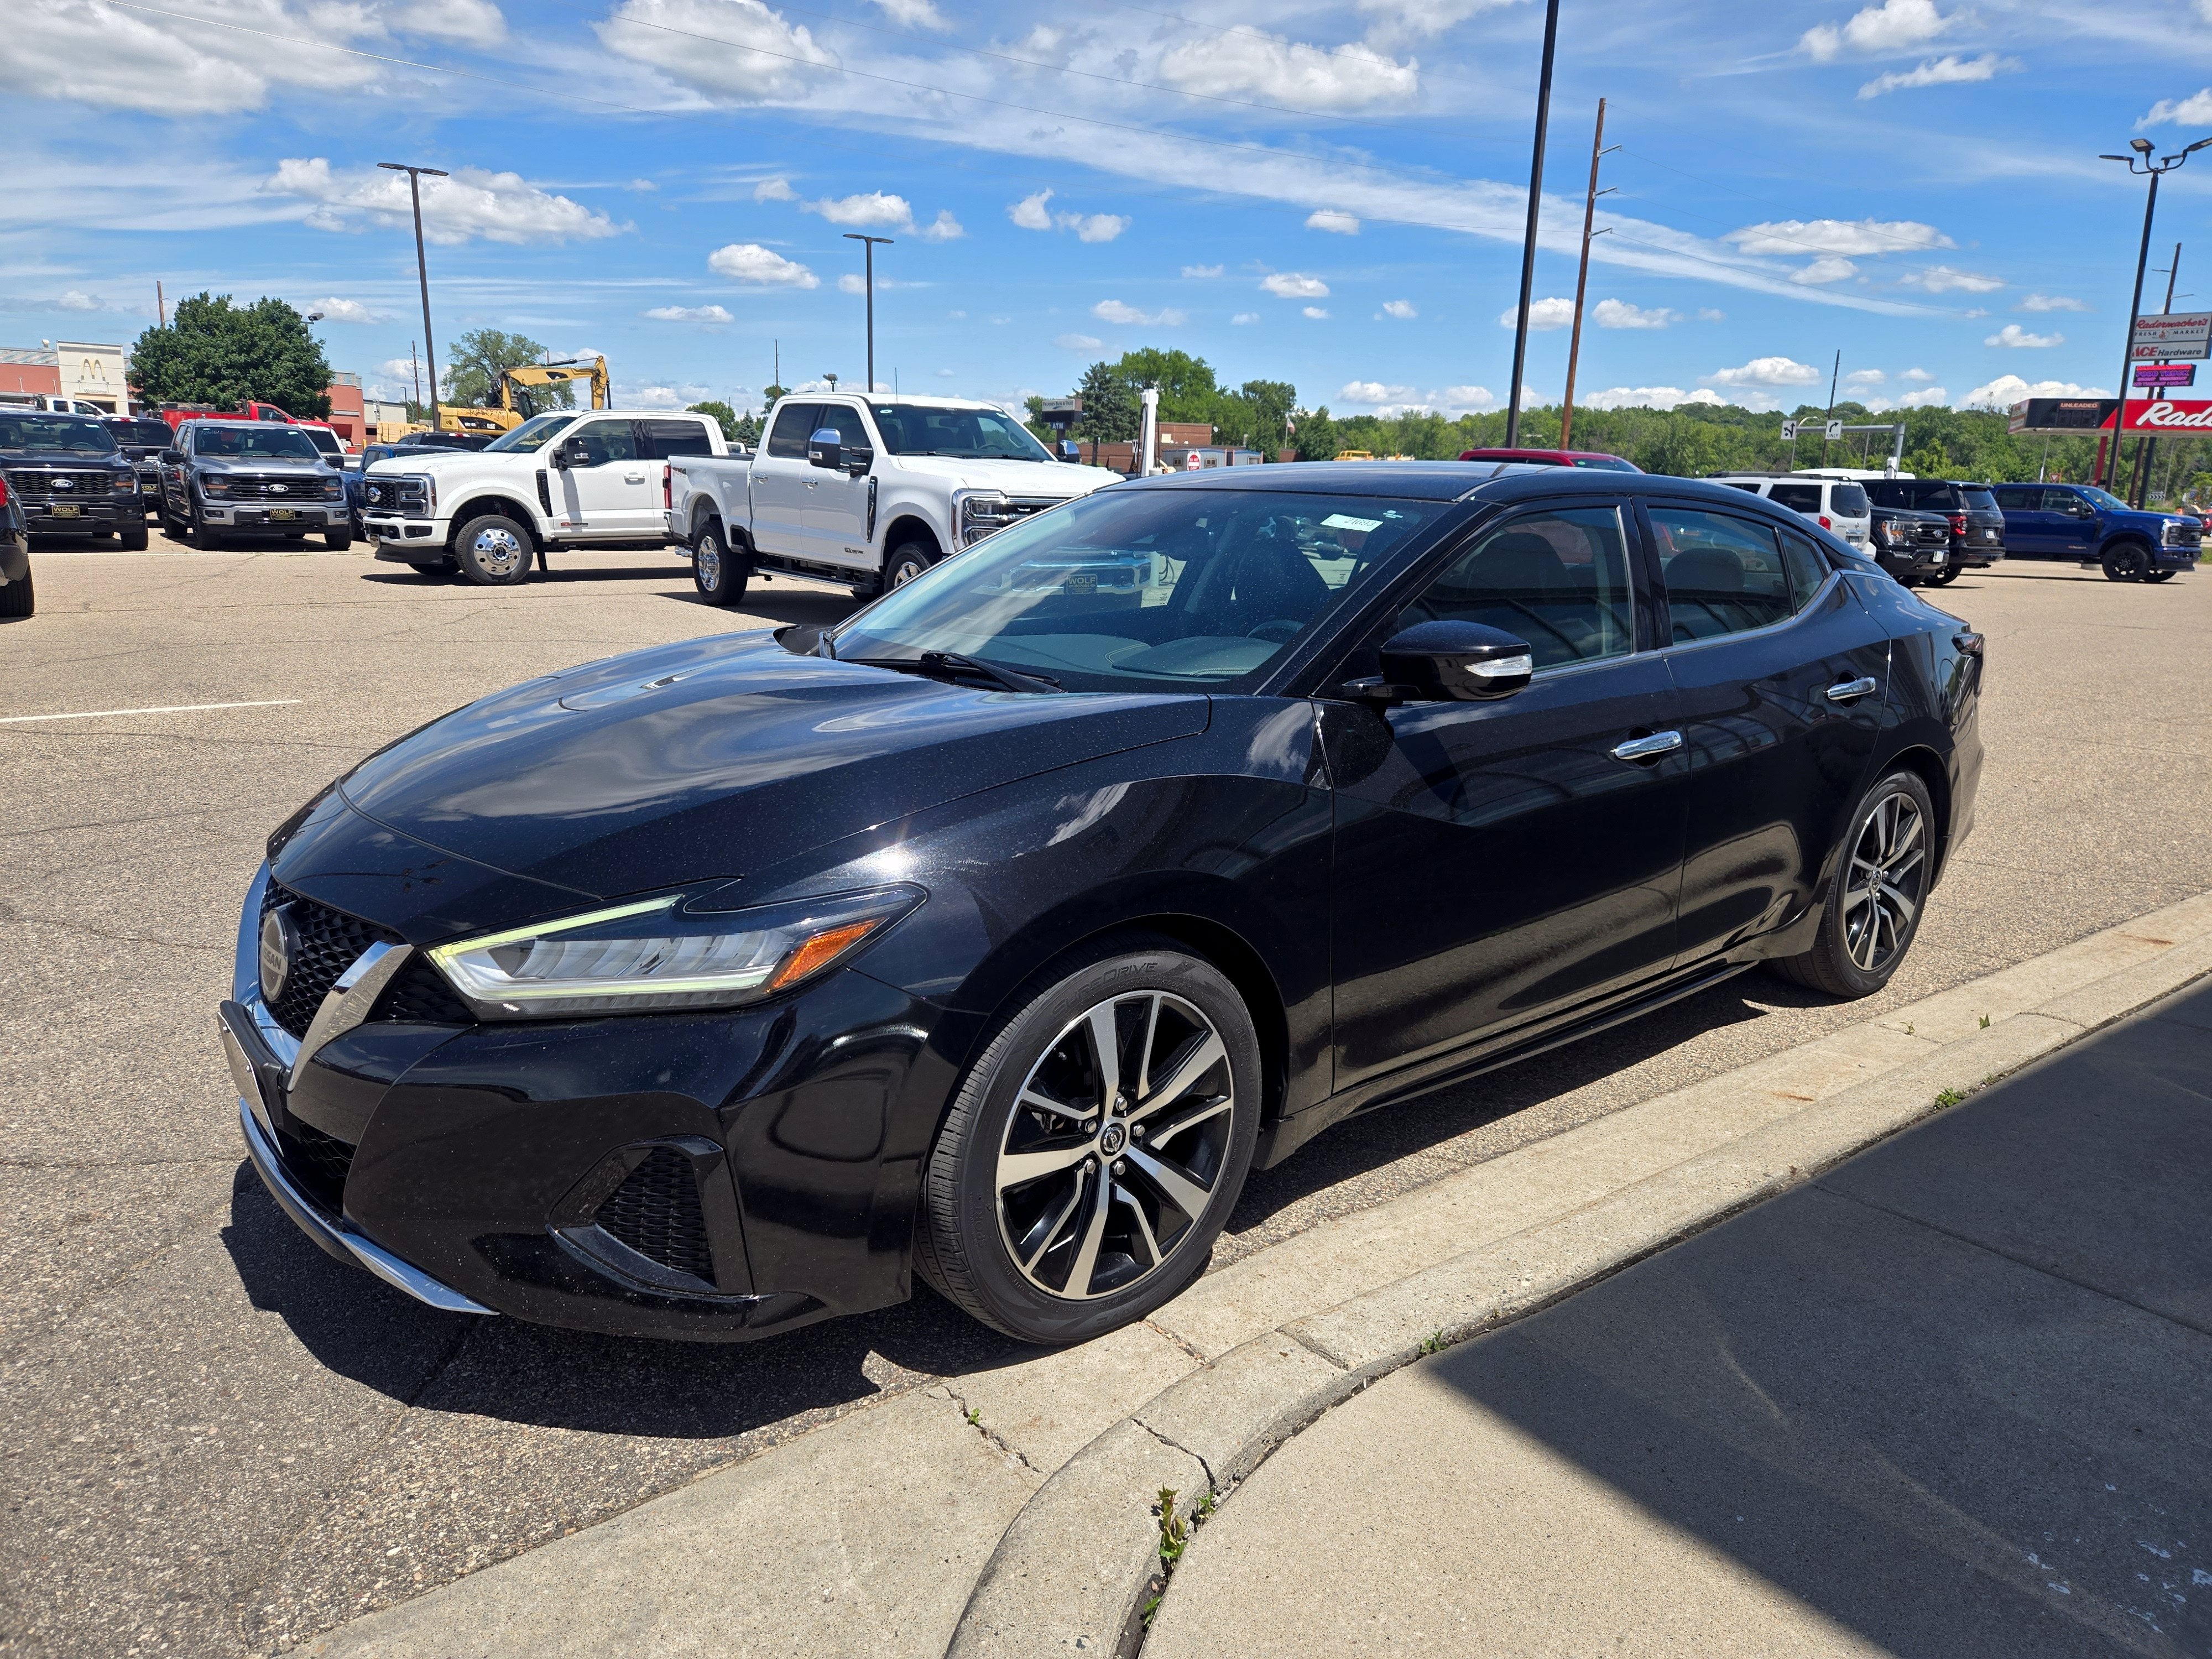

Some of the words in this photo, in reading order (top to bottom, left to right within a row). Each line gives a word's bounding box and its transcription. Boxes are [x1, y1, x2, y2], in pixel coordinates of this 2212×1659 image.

[2136, 319, 2208, 329] Radermacher's
[2132, 346, 2158, 357] ACE
[1344, 518, 1376, 526] 21693
